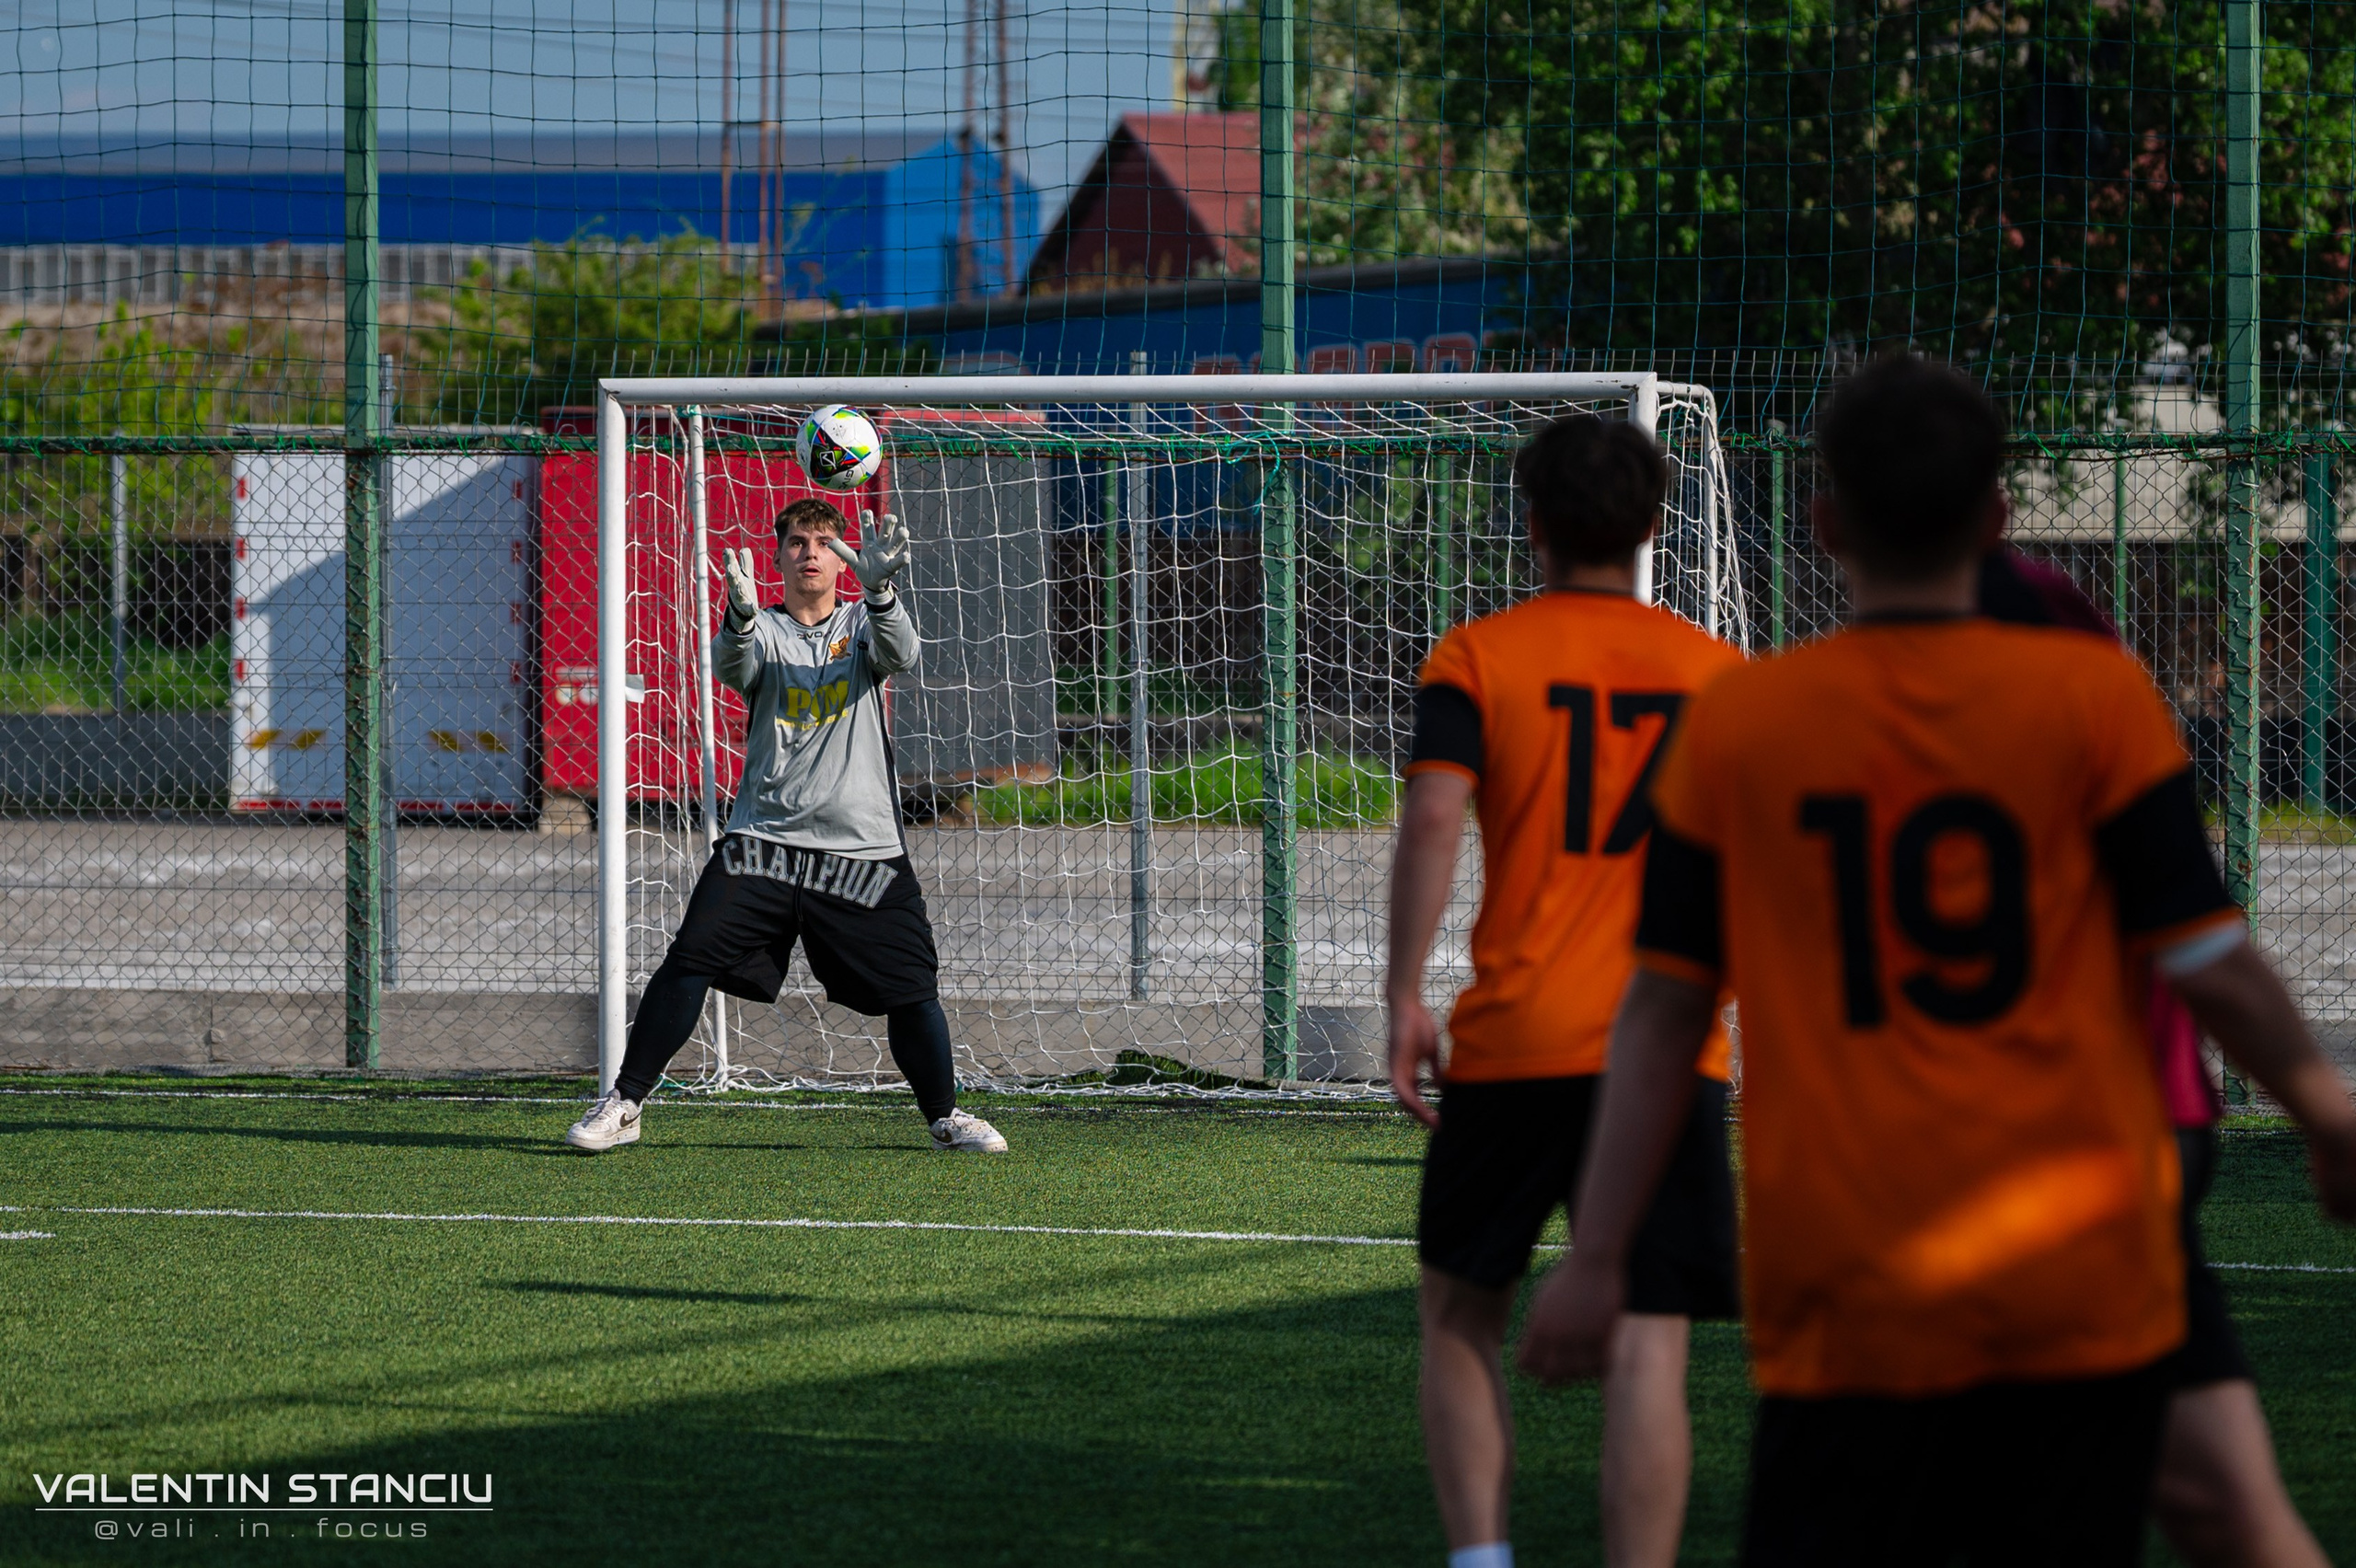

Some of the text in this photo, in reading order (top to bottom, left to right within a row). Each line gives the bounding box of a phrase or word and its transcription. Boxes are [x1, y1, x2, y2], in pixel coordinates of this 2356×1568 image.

[1547, 683, 1690, 857] 17
[722, 836, 898, 909] CHAMPION
[1801, 791, 2031, 1031] 19
